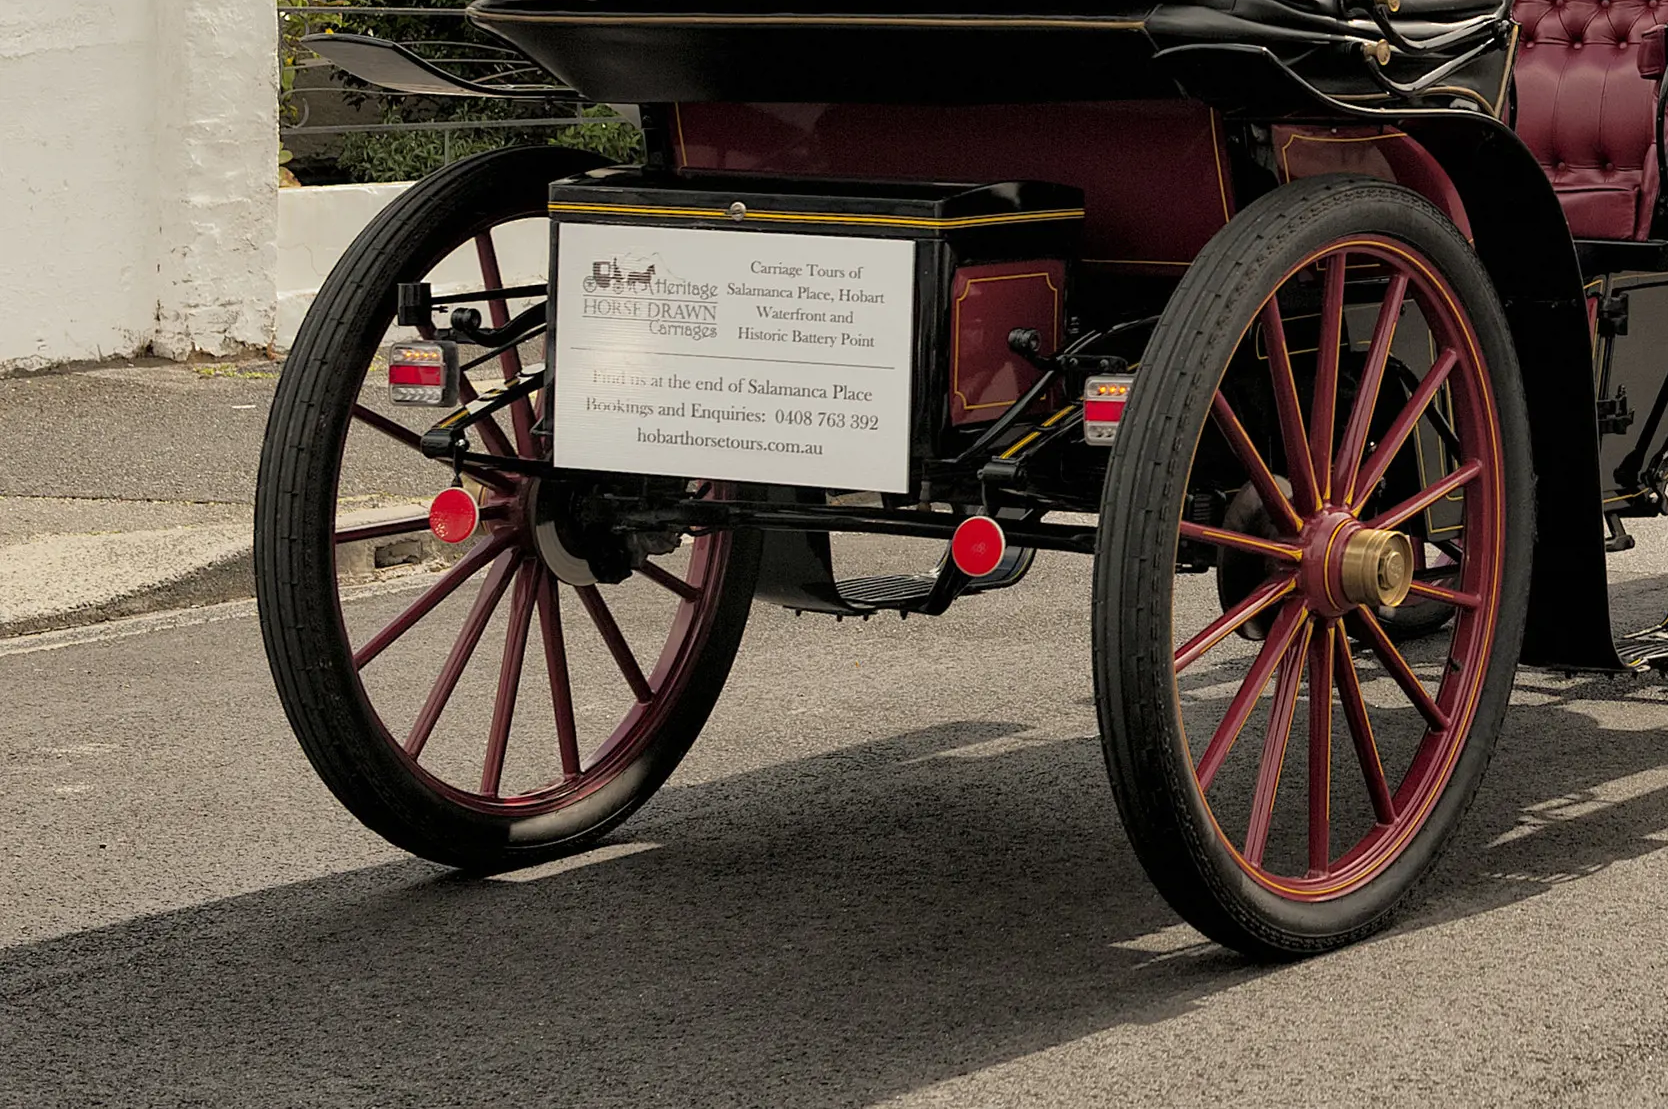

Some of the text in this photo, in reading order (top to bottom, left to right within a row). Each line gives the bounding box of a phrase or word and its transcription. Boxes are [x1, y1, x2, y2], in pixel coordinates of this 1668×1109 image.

[750, 260, 864, 280] Carriage Tours of
[654, 278, 719, 300] Heritage
[727, 282, 885, 304] Salamanca Place, Hobart
[647, 301, 717, 321] DRAWN
[756, 305, 854, 324] Waterfront and
[649, 319, 718, 341] Carriages
[737, 326, 875, 348] Historic Battery Point
[650, 376, 664, 388] at
[668, 373, 691, 390] the
[695, 376, 724, 392] end
[728, 377, 745, 393] of
[747, 378, 828, 399] Salamanca
[832, 383, 873, 402] Place
[586, 396, 879, 431] Bookings and Enquiries: 0408 763 392
[637, 426, 823, 455] hobarthorsetours.com.au
